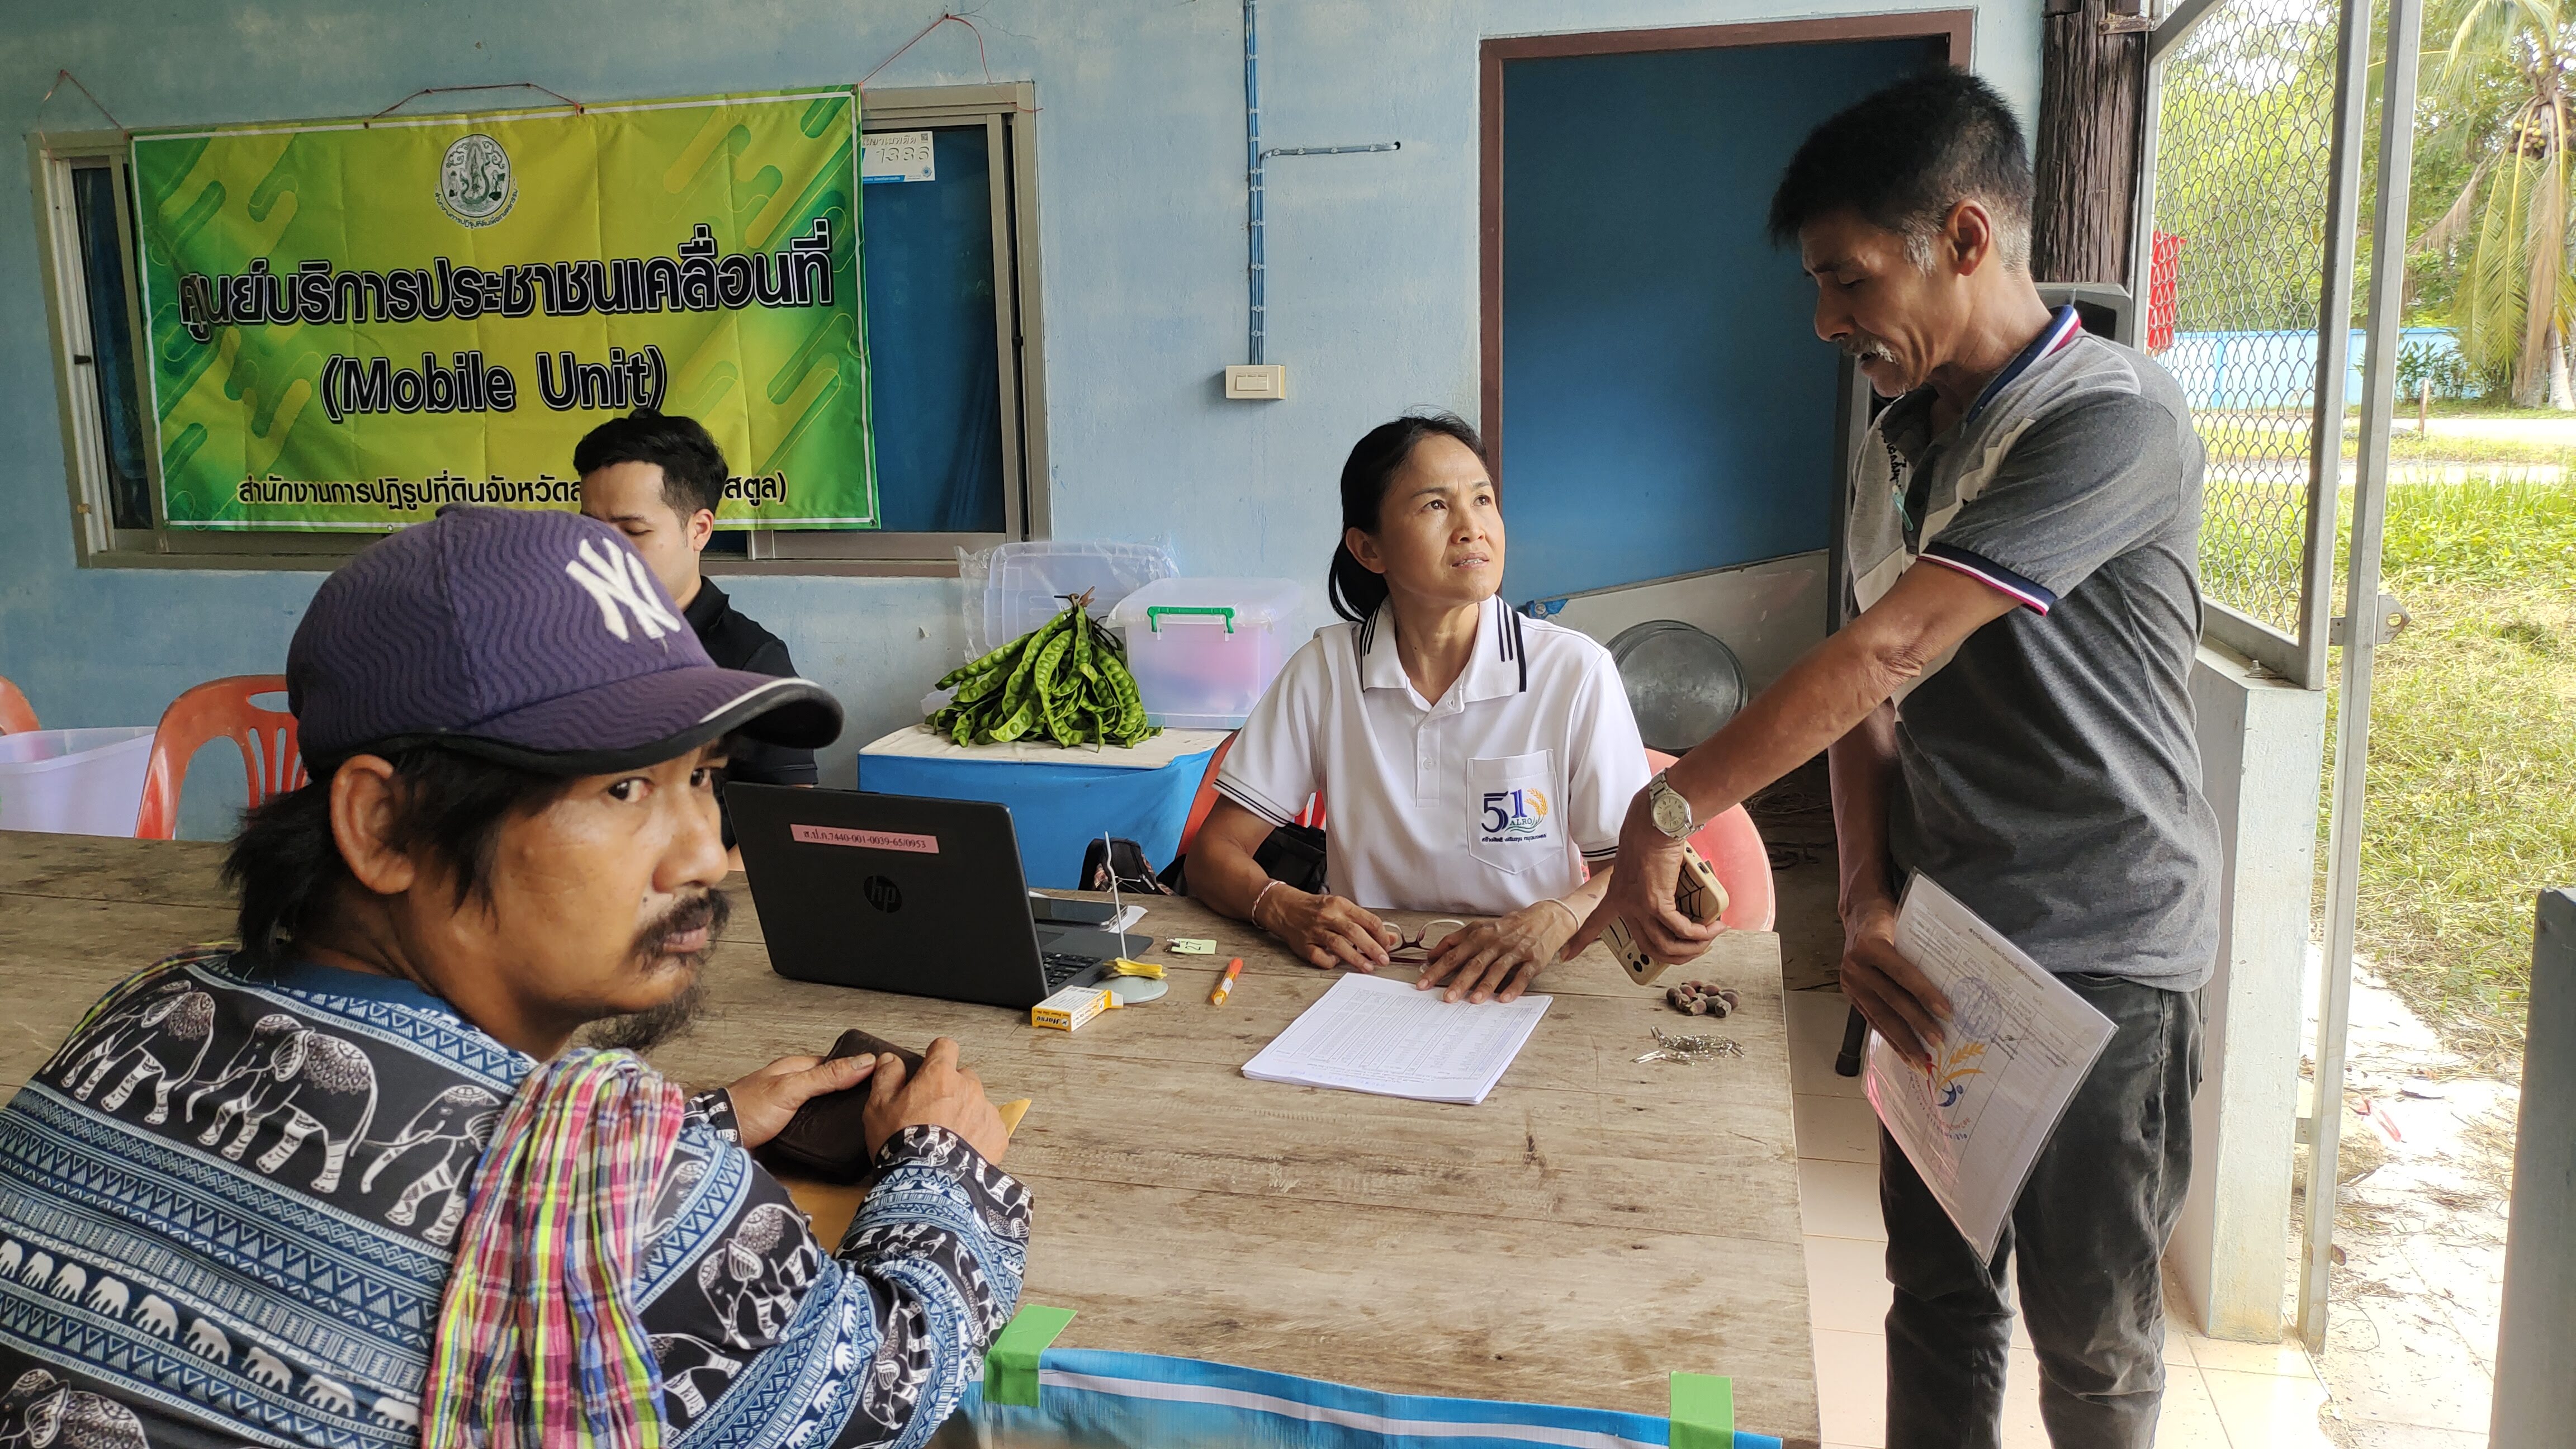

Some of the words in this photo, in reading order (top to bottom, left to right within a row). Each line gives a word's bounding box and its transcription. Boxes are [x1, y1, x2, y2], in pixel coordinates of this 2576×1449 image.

[179, 217, 835, 343] ศูนย์บริการประชาชนเคลื่อนที่
[320, 351, 517, 423] (Mobile
[536, 345, 667, 411] Unit)
[239, 470, 581, 510] สำนักงานการปฏิรูปที่ดินจังหวัดส
[724, 472, 786, 506] สตูล)
[1481, 789, 1527, 833] 51
[868, 875, 898, 913] hp
[1036, 1015, 1060, 1025] Horse
